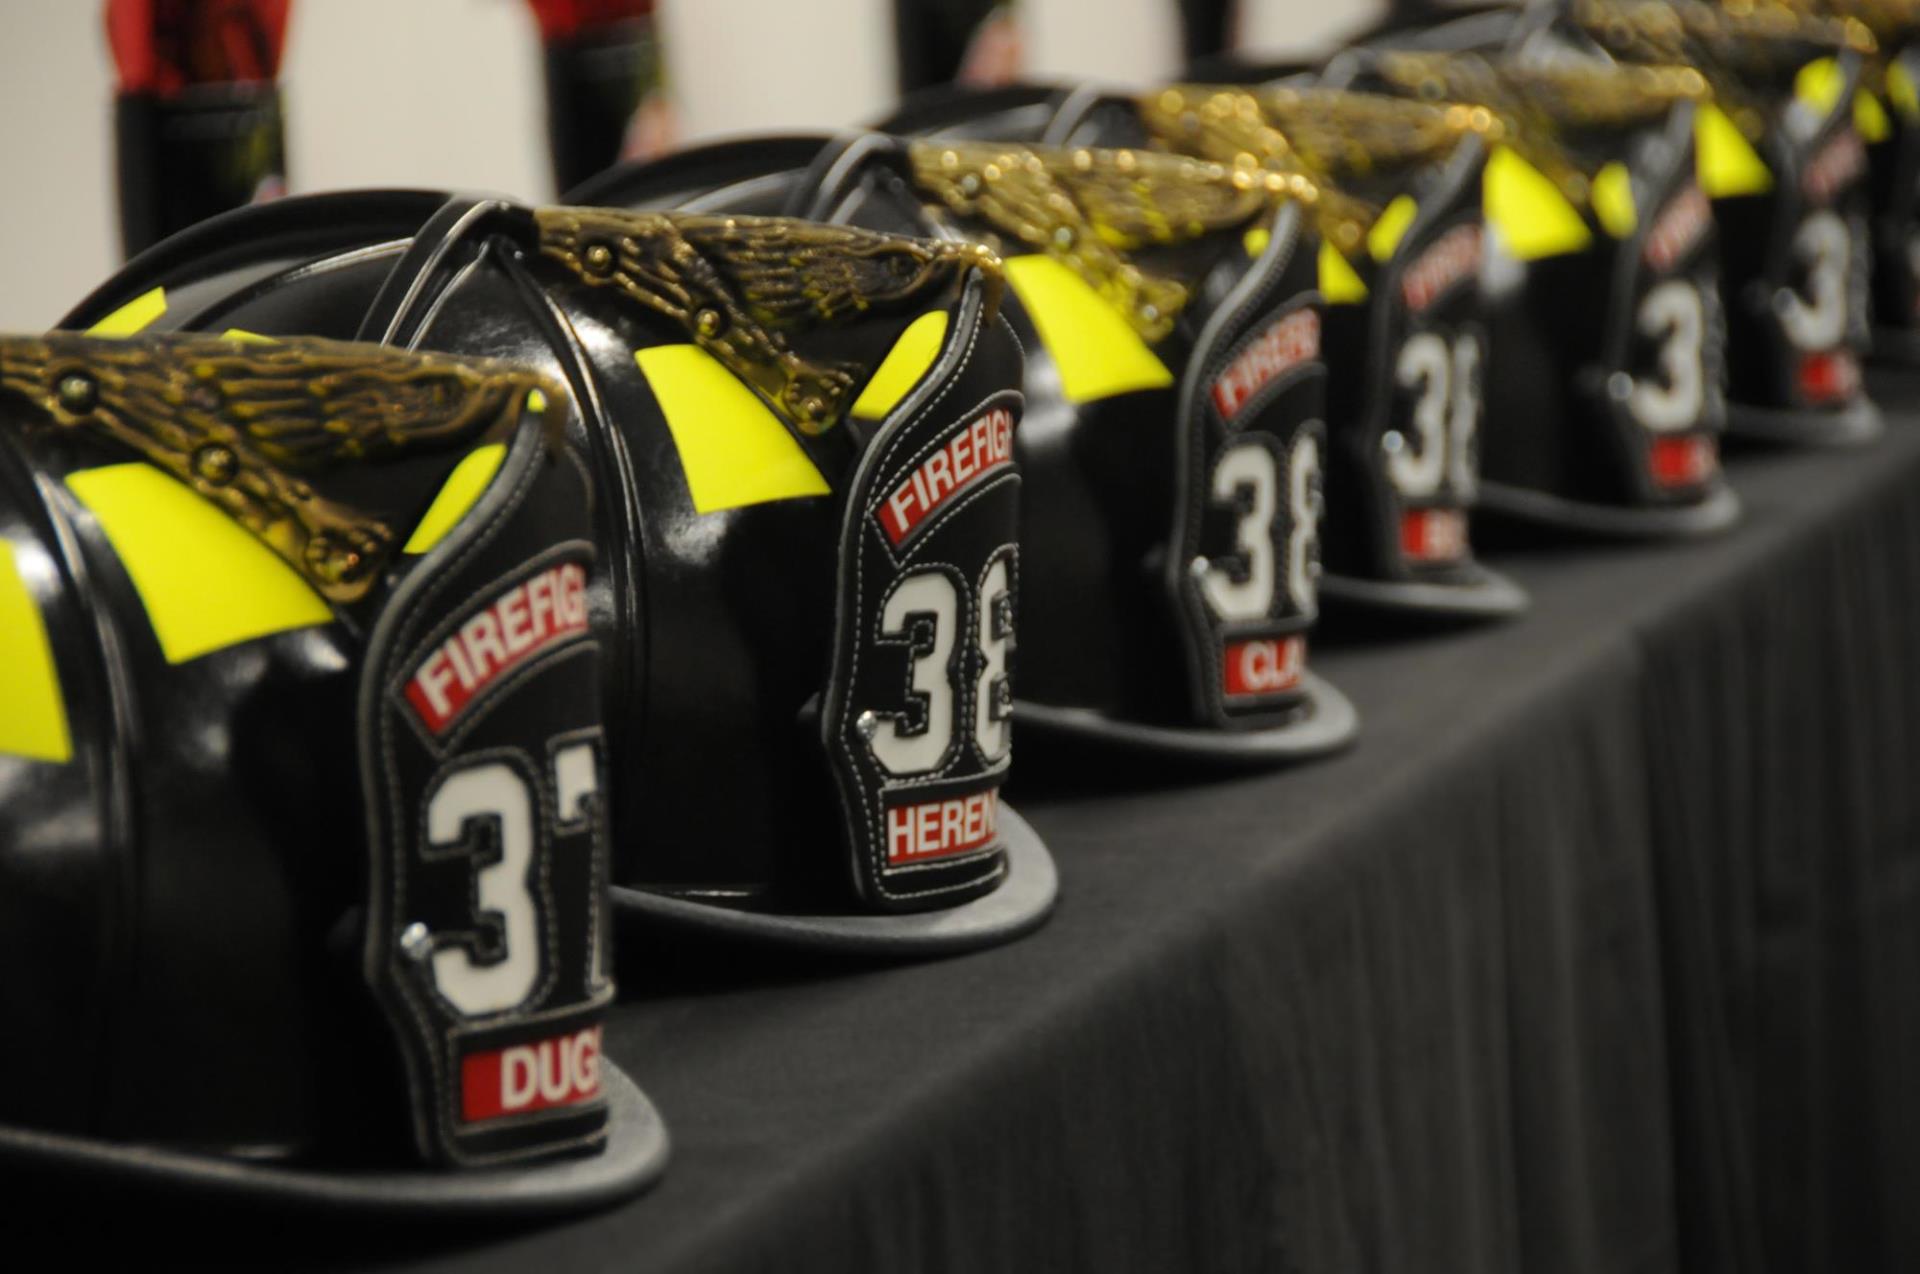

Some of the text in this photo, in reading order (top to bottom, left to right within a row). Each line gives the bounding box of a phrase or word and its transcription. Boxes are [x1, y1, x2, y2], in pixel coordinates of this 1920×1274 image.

[1630, 280, 1725, 432] 3
[416, 563, 588, 717] FIREFIG
[871, 557, 1013, 774] 38
